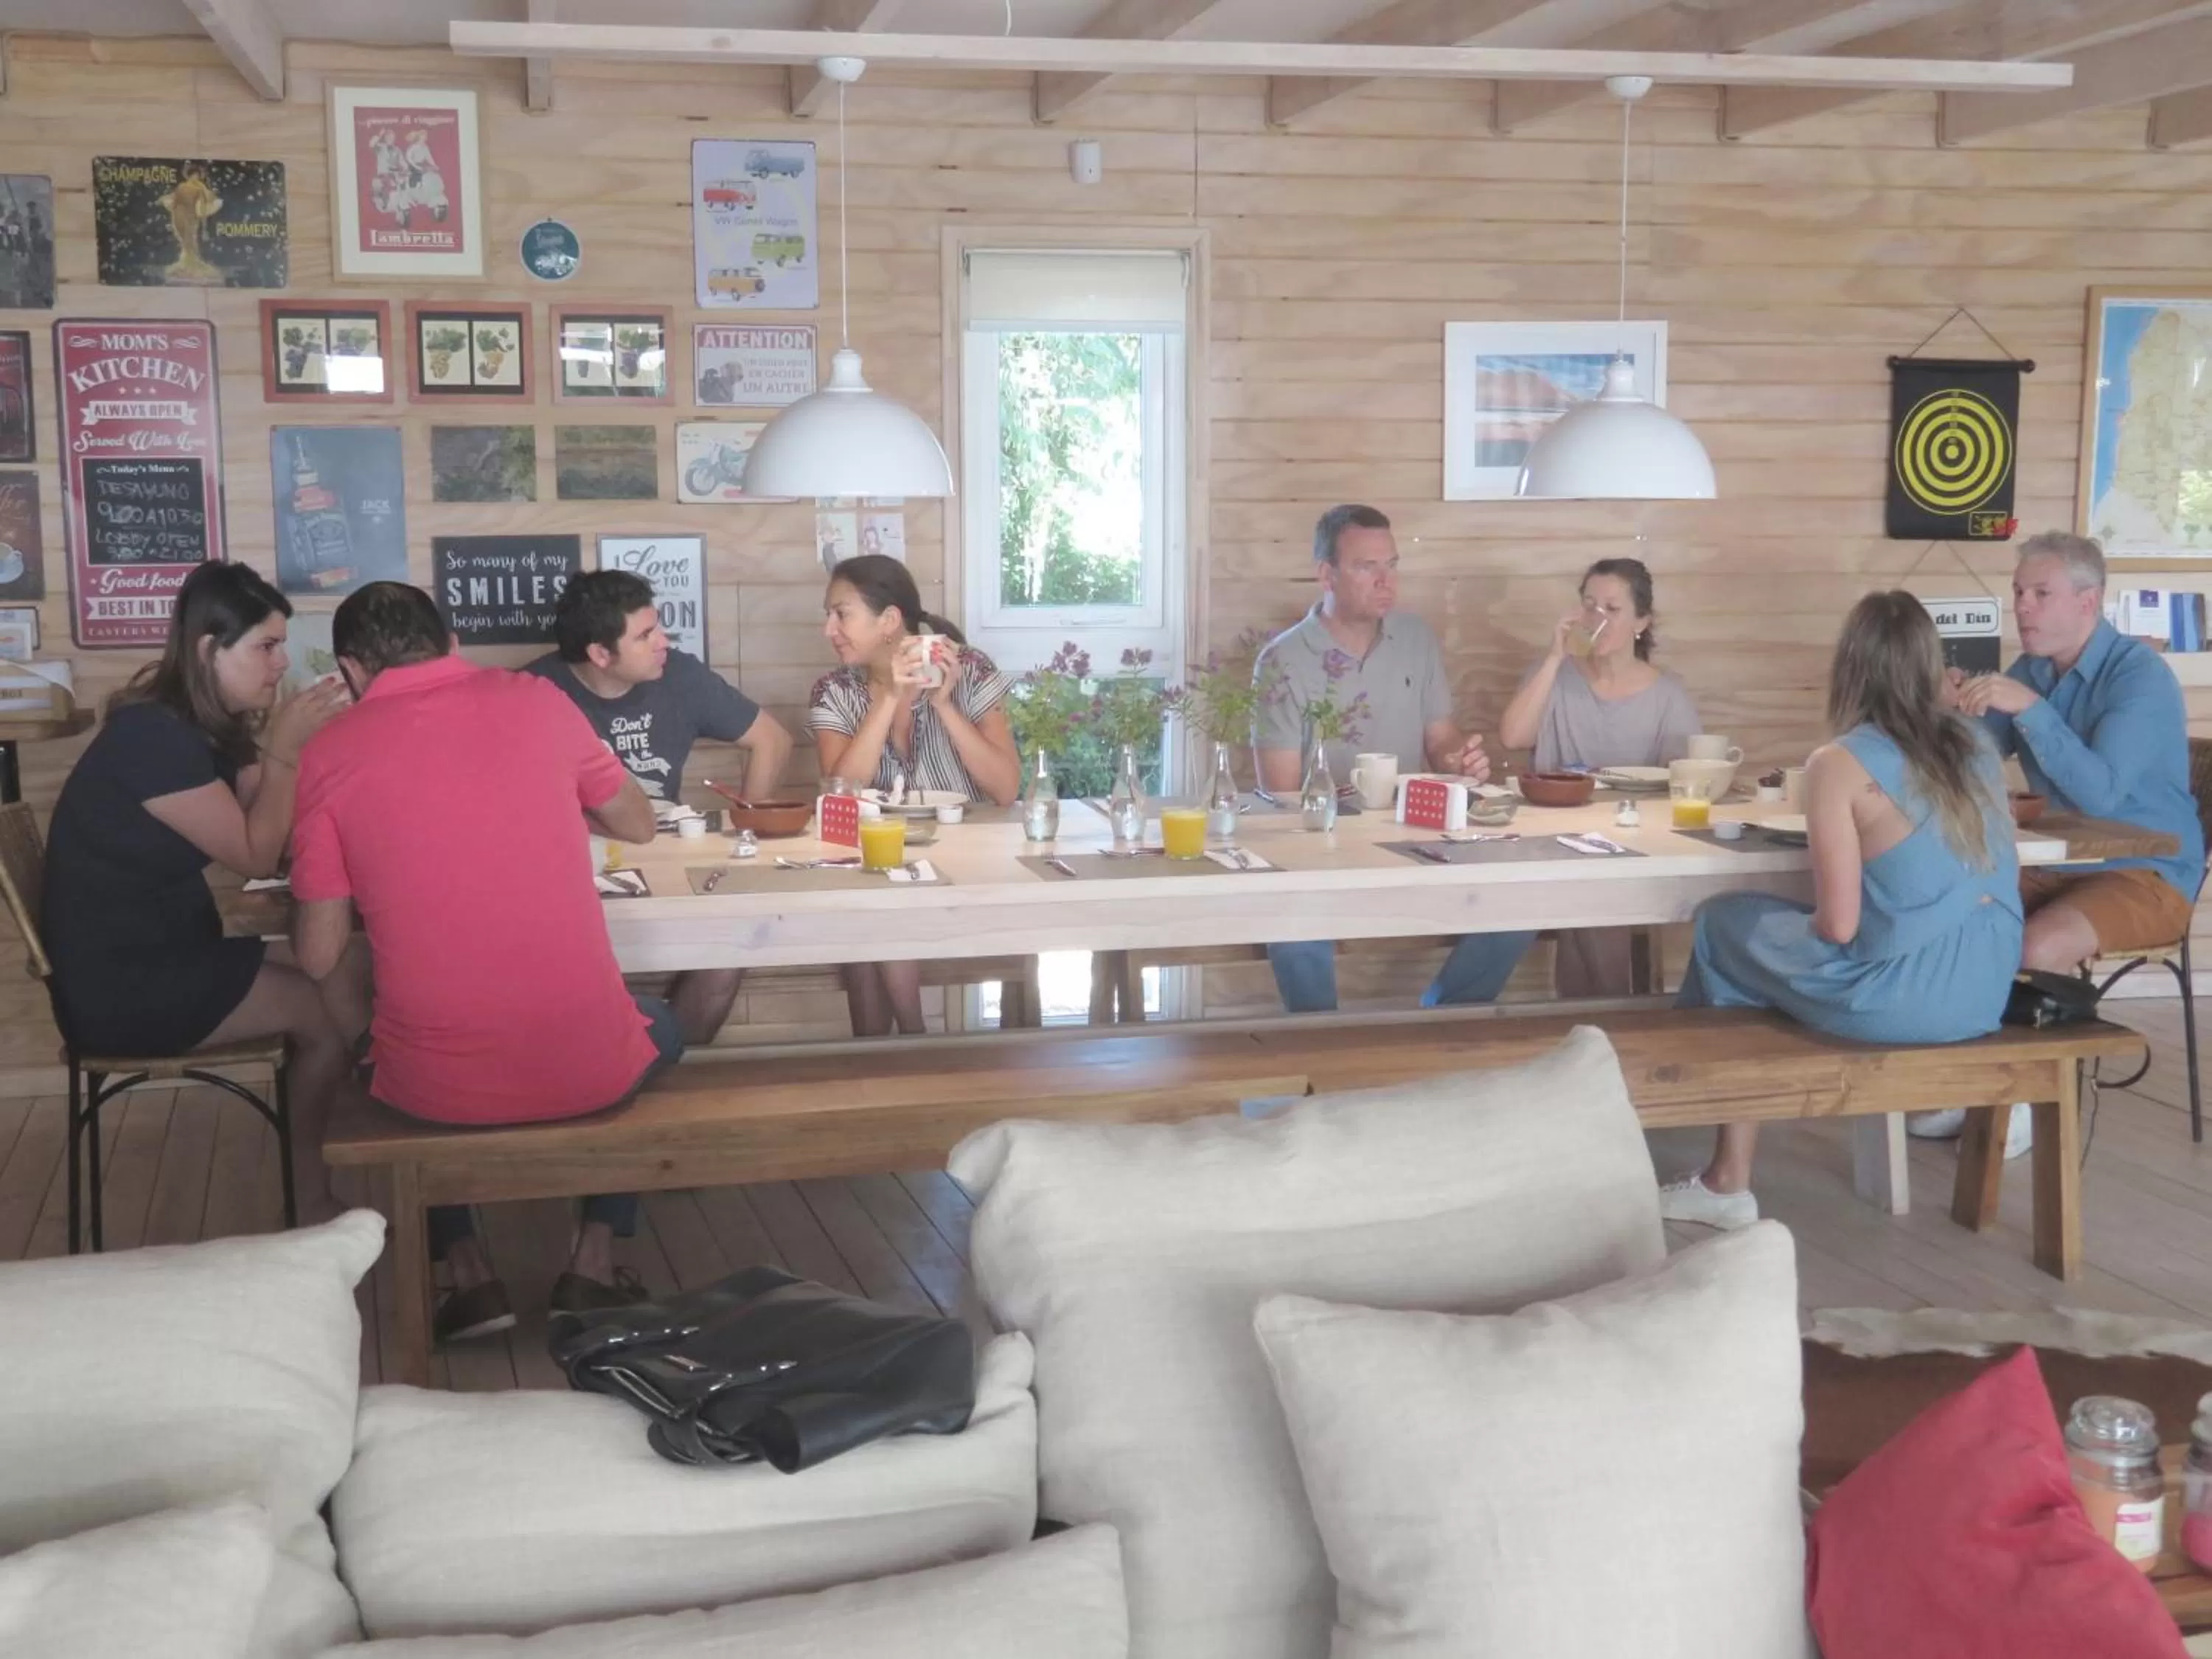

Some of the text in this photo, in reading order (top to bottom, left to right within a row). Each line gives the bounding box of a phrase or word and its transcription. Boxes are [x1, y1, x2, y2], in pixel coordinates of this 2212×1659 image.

[99, 165, 177, 184] CHAMPAGNE
[216, 223, 278, 237] POMMERY
[101, 333, 169, 351] MOM'S
[703, 330, 808, 349] ATTENTION
[68, 355, 206, 394] KITCHEN
[94, 404, 147, 417] ALWAYS
[446, 550, 569, 573] So many of my
[613, 545, 690, 578] I Love
[99, 568, 186, 594] Good food
[447, 575, 567, 607] SMILES
[97, 601, 135, 616] BEST
[139, 599, 158, 615] IN
[660, 601, 696, 628] ON
[452, 611, 558, 633] begin with yo
[610, 712, 653, 735] Don't
[616, 732, 650, 751] BITE
